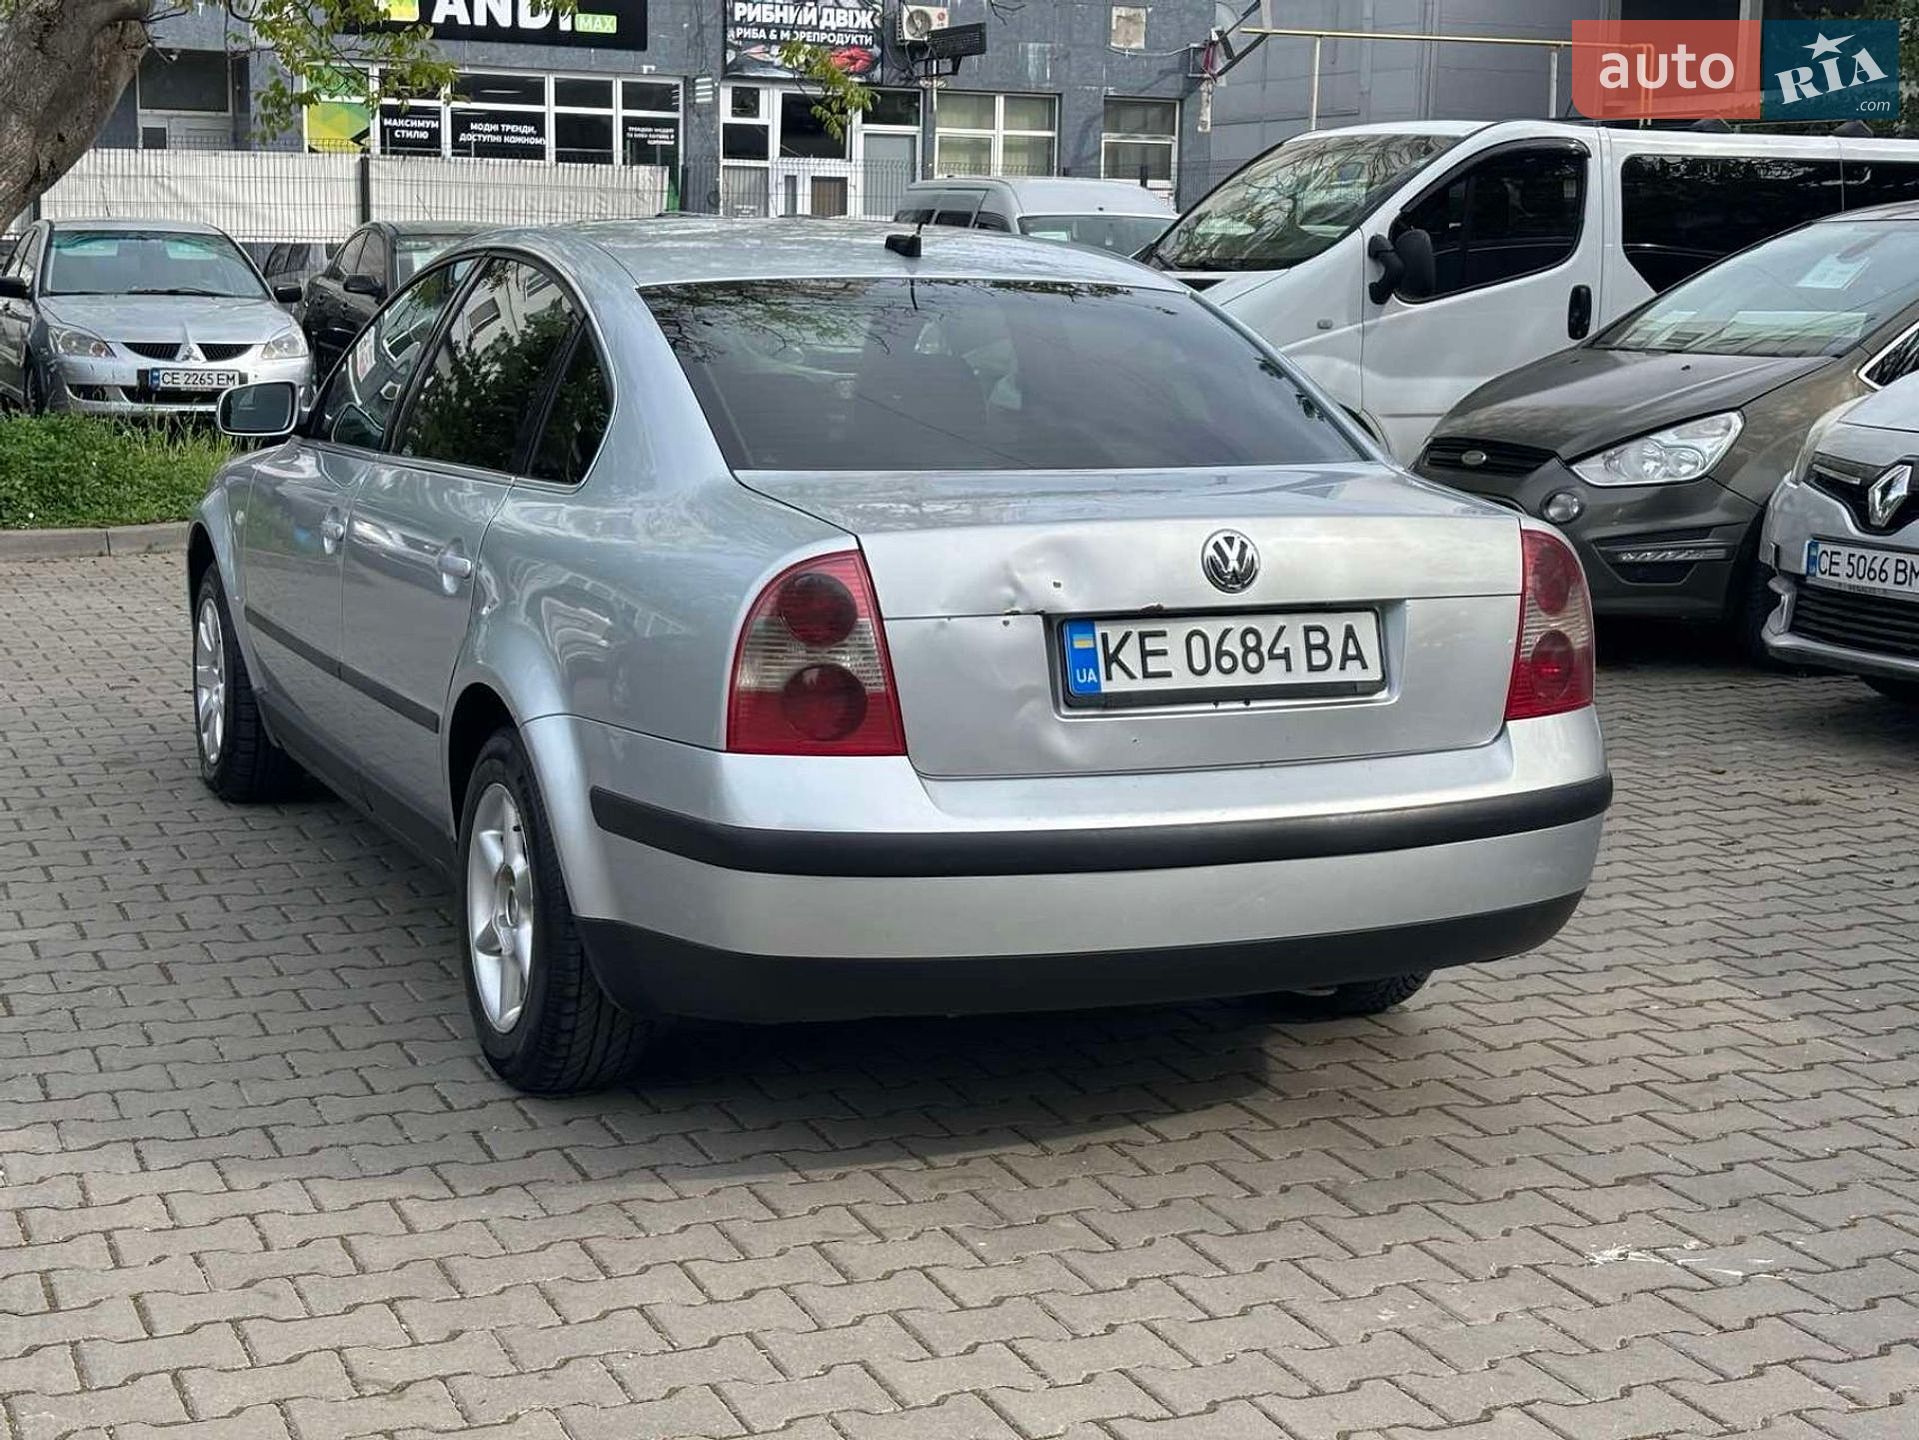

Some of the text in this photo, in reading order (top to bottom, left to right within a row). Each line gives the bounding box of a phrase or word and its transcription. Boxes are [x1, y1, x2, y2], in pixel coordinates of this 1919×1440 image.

[578, 15, 613, 31] MAX
[734, 2, 875, 30] РИБНИЙ ДВІЖ
[736, 27, 767, 40] РИБА
[769, 30, 777, 40] &
[383, 117, 439, 128] МАКСИМУМ
[470, 122, 498, 131] МОДНІ
[394, 129, 429, 139] СТИЛЮ
[459, 133, 502, 143] ДОСТУПНІ
[162, 372, 236, 386] CE 2265 EM
[1818, 550, 1841, 577] CE
[1846, 553, 1889, 583] 5066
[1100, 623, 1369, 681] KE 0684 BA
[1076, 668, 1098, 684] UA
